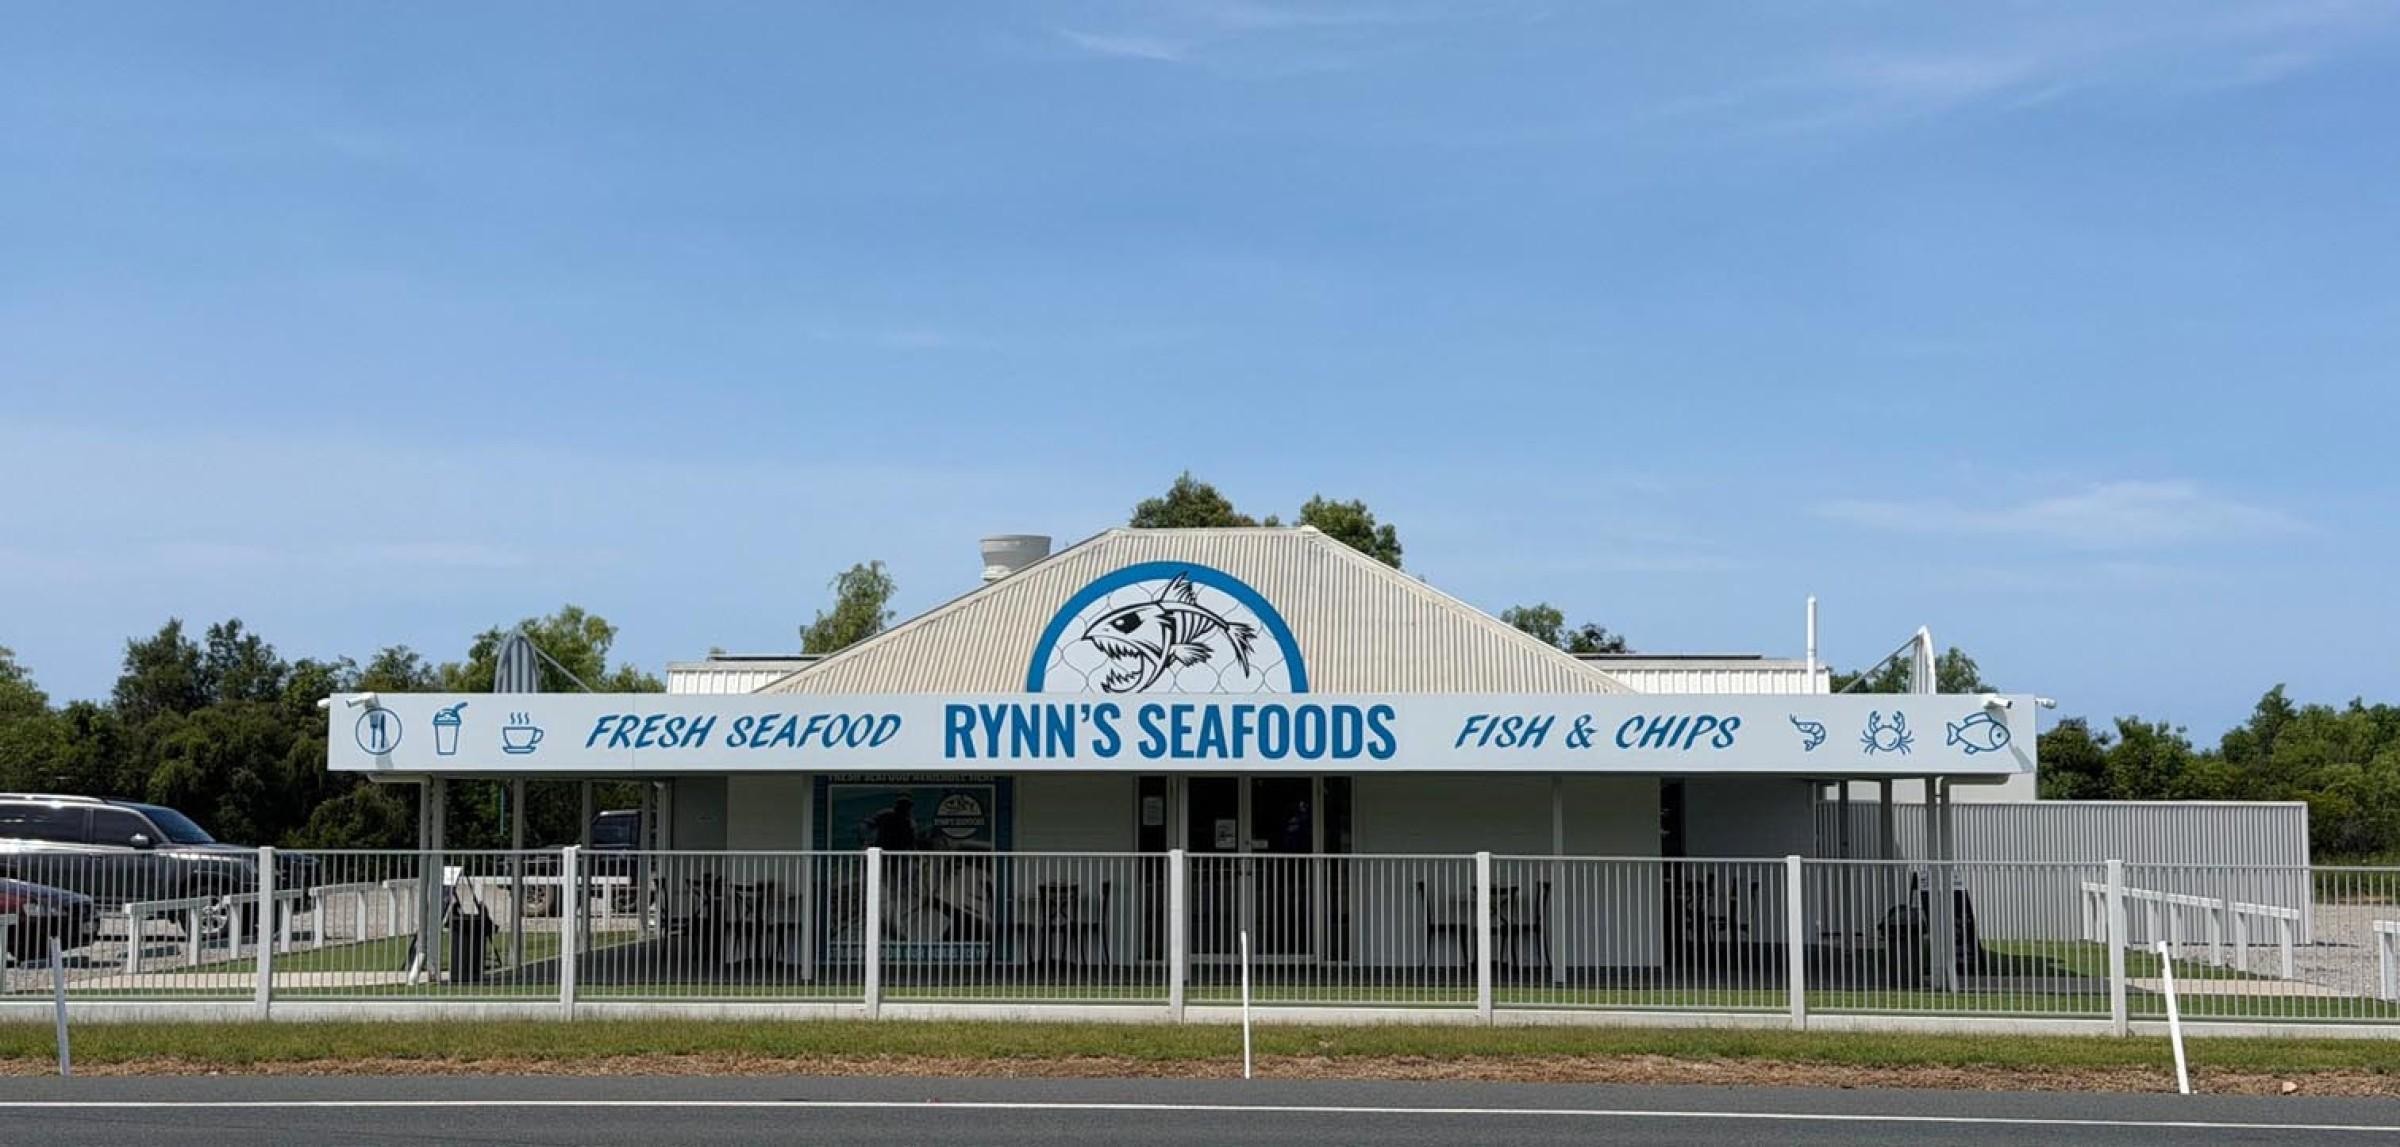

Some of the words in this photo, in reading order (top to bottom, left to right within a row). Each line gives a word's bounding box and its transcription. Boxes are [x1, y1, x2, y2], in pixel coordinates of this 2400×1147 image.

[586, 713, 717, 749] FRESH
[726, 713, 902, 749] SEAFOOD
[944, 703, 1122, 759] RYNN'S
[1138, 703, 1398, 760] SEAFOODS
[1455, 714, 1556, 749] FISH
[1565, 714, 1597, 750] &
[1615, 714, 1741, 750] CHIPS
